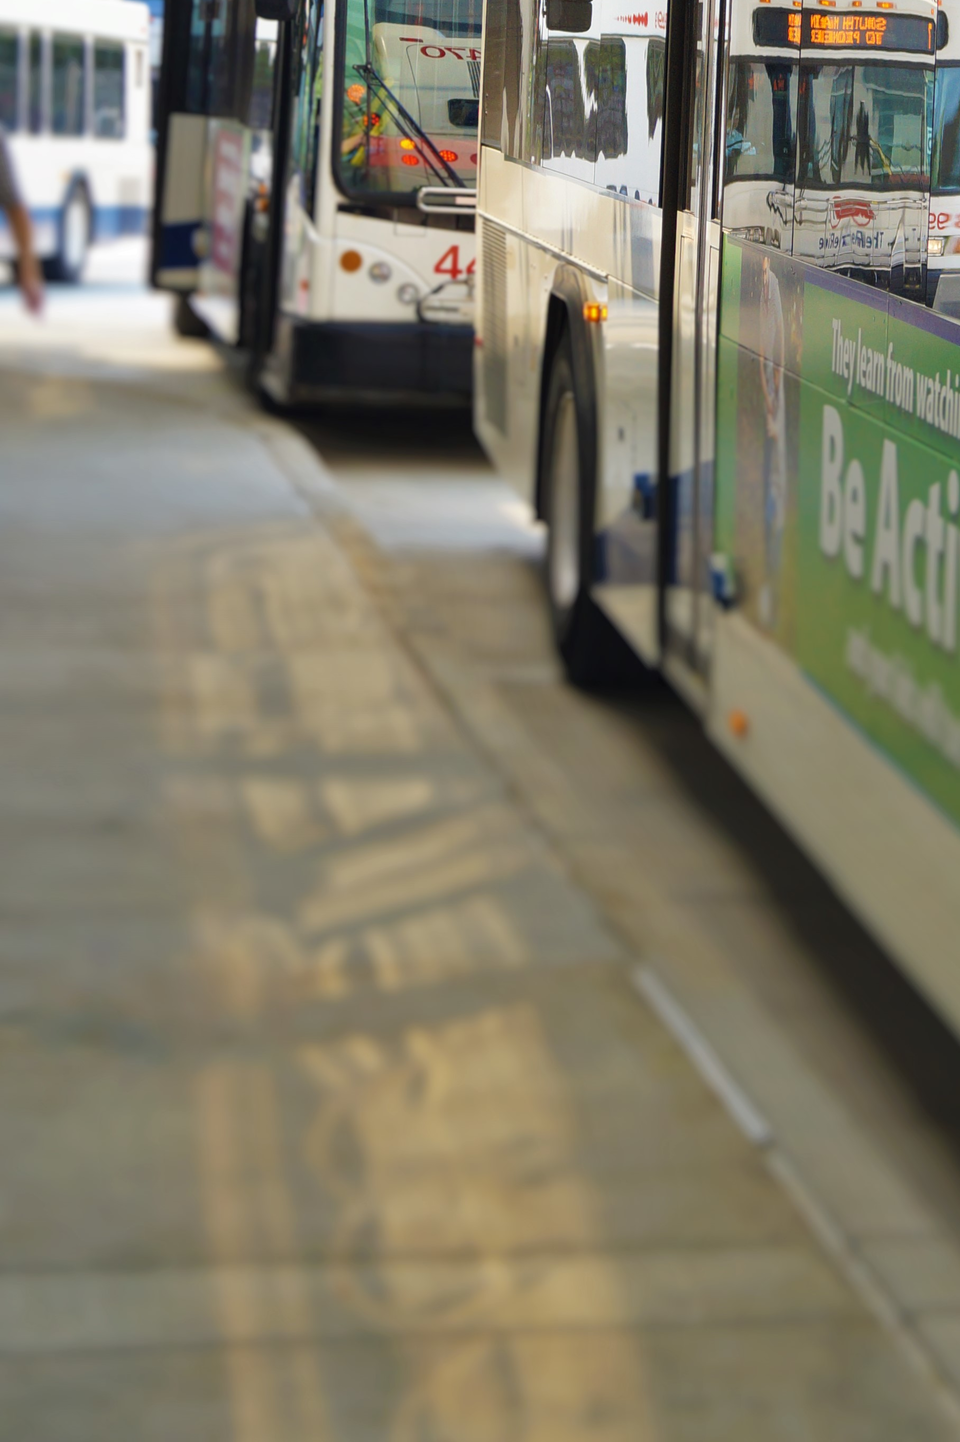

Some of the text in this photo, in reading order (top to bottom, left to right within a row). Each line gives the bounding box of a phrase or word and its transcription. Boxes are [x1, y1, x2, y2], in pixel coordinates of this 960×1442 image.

[832, 317, 856, 396] They
[856, 327, 885, 397] learn
[886, 341, 914, 414] from
[820, 403, 867, 580] Be
